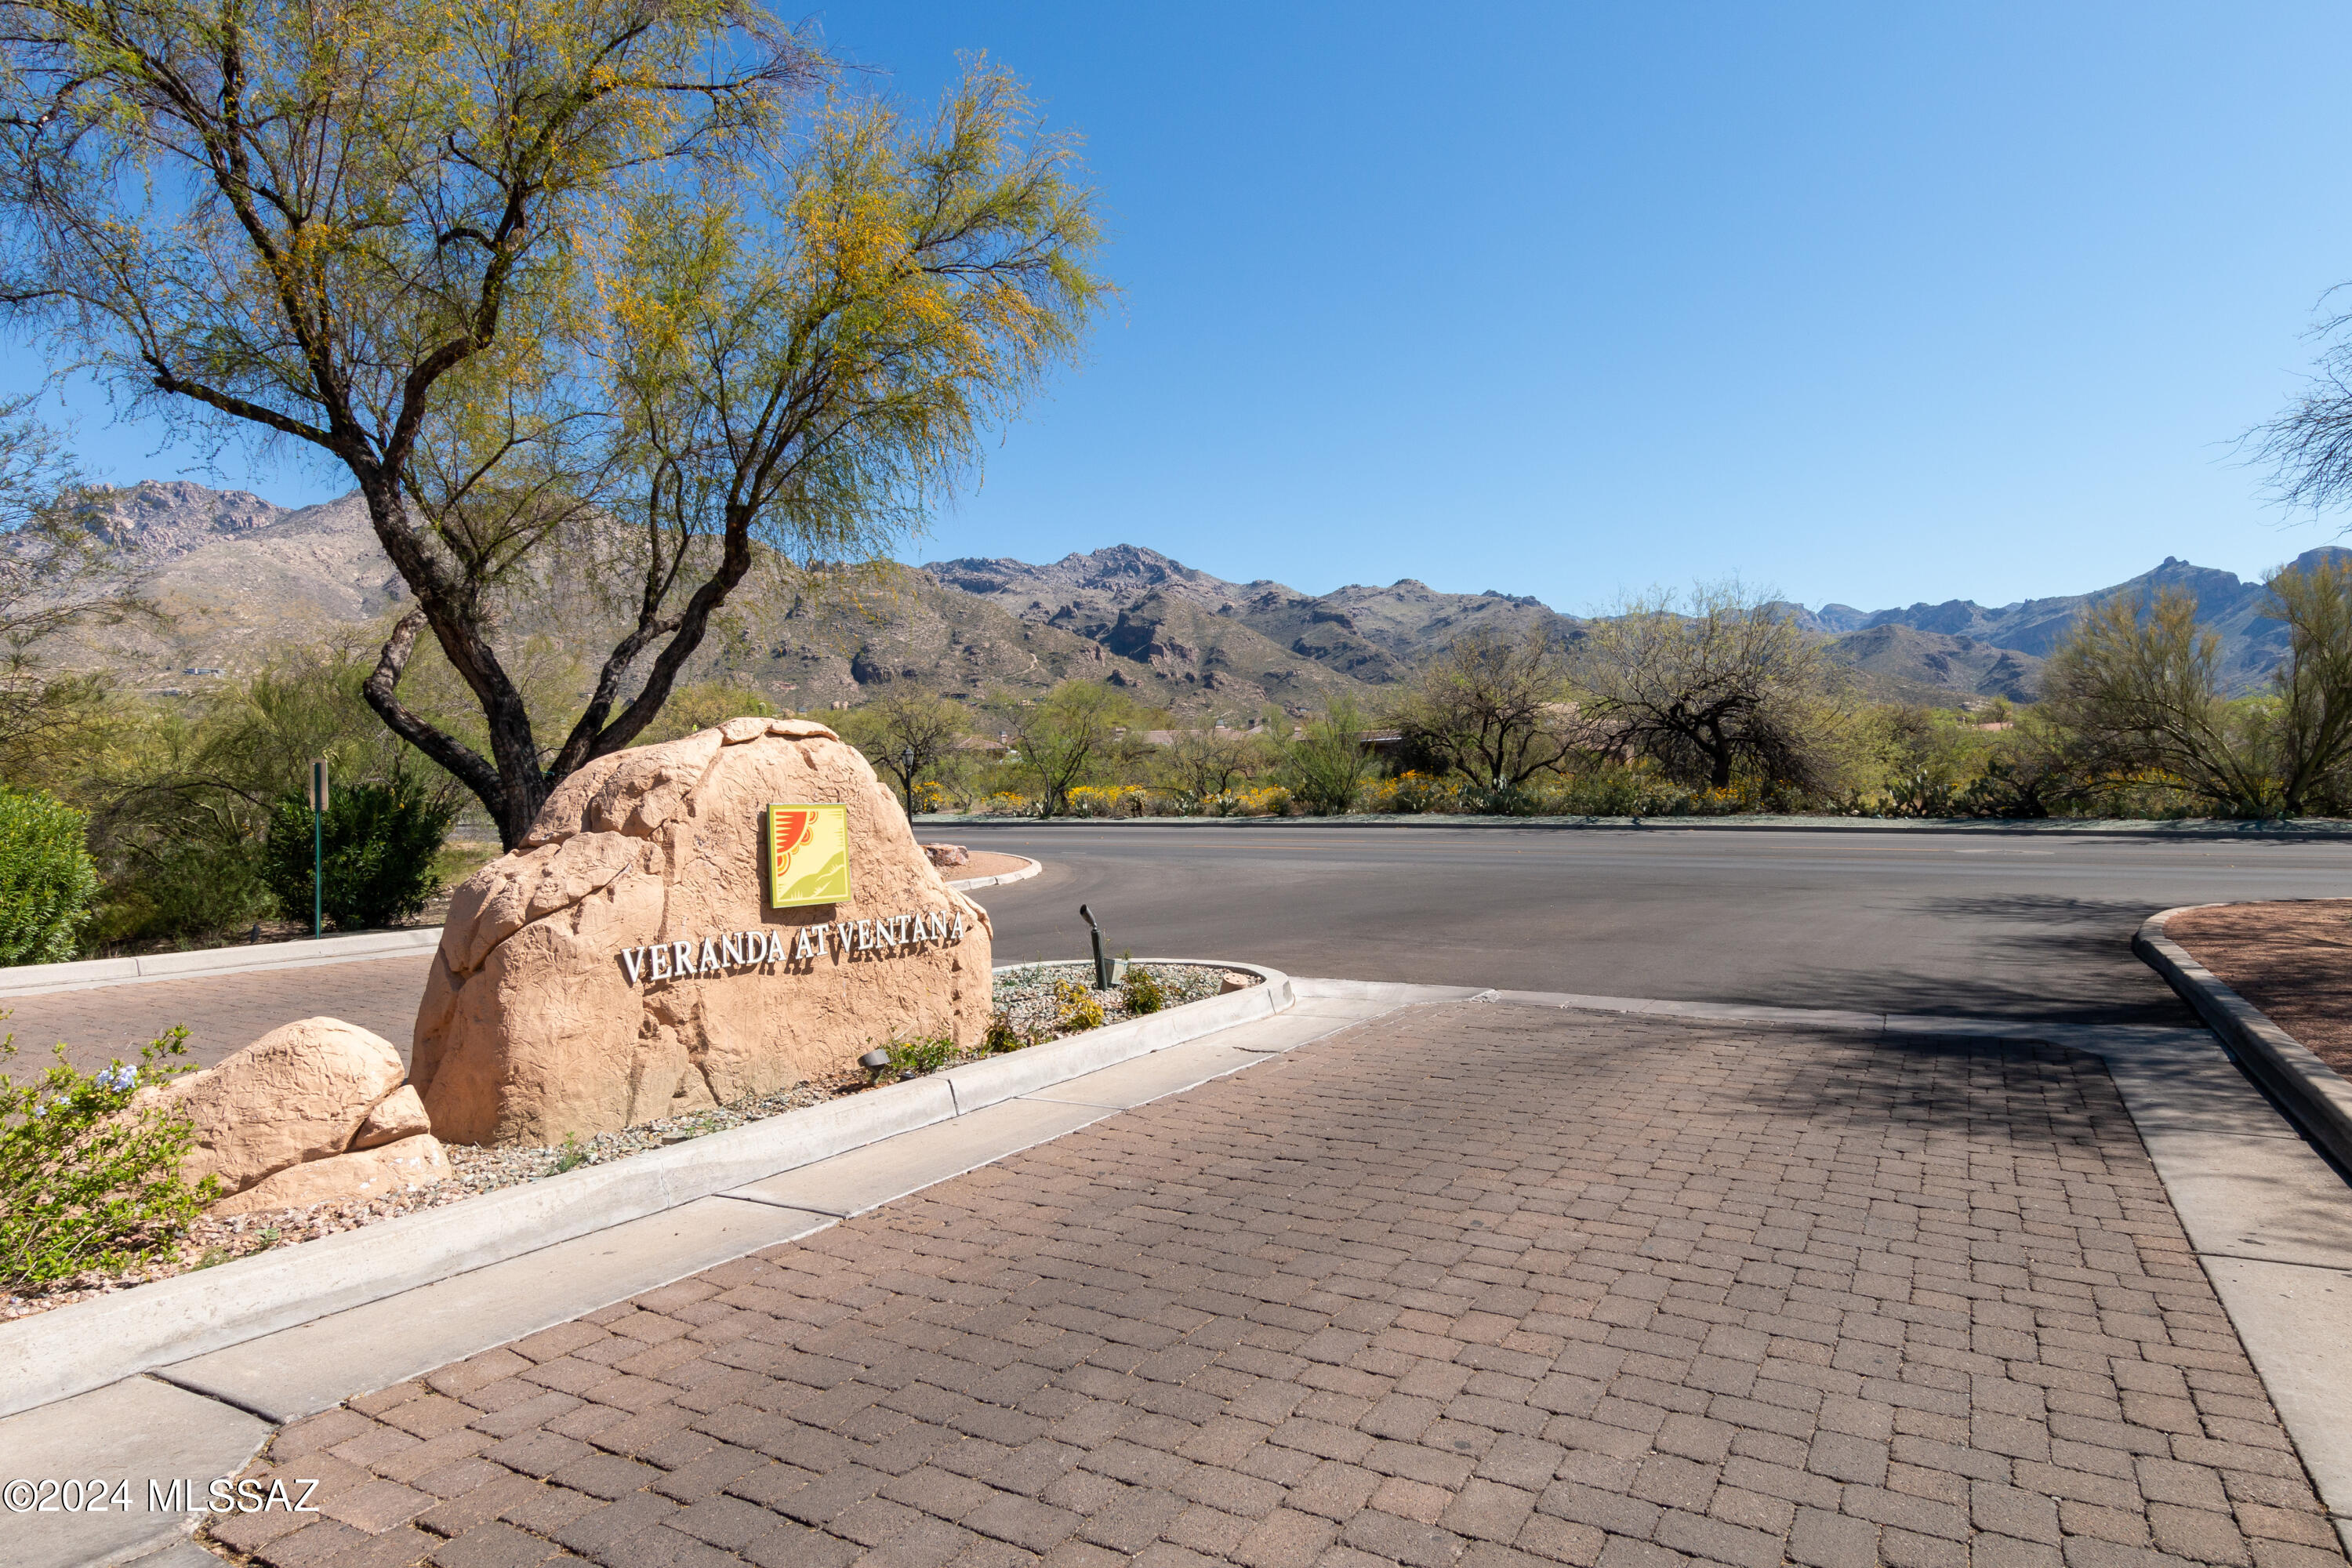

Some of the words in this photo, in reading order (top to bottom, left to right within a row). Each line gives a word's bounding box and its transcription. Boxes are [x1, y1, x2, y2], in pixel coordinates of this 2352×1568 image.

[620, 930, 786, 983] VERANDA
[796, 925, 829, 960] AT
[837, 910, 964, 953] VENTANA
